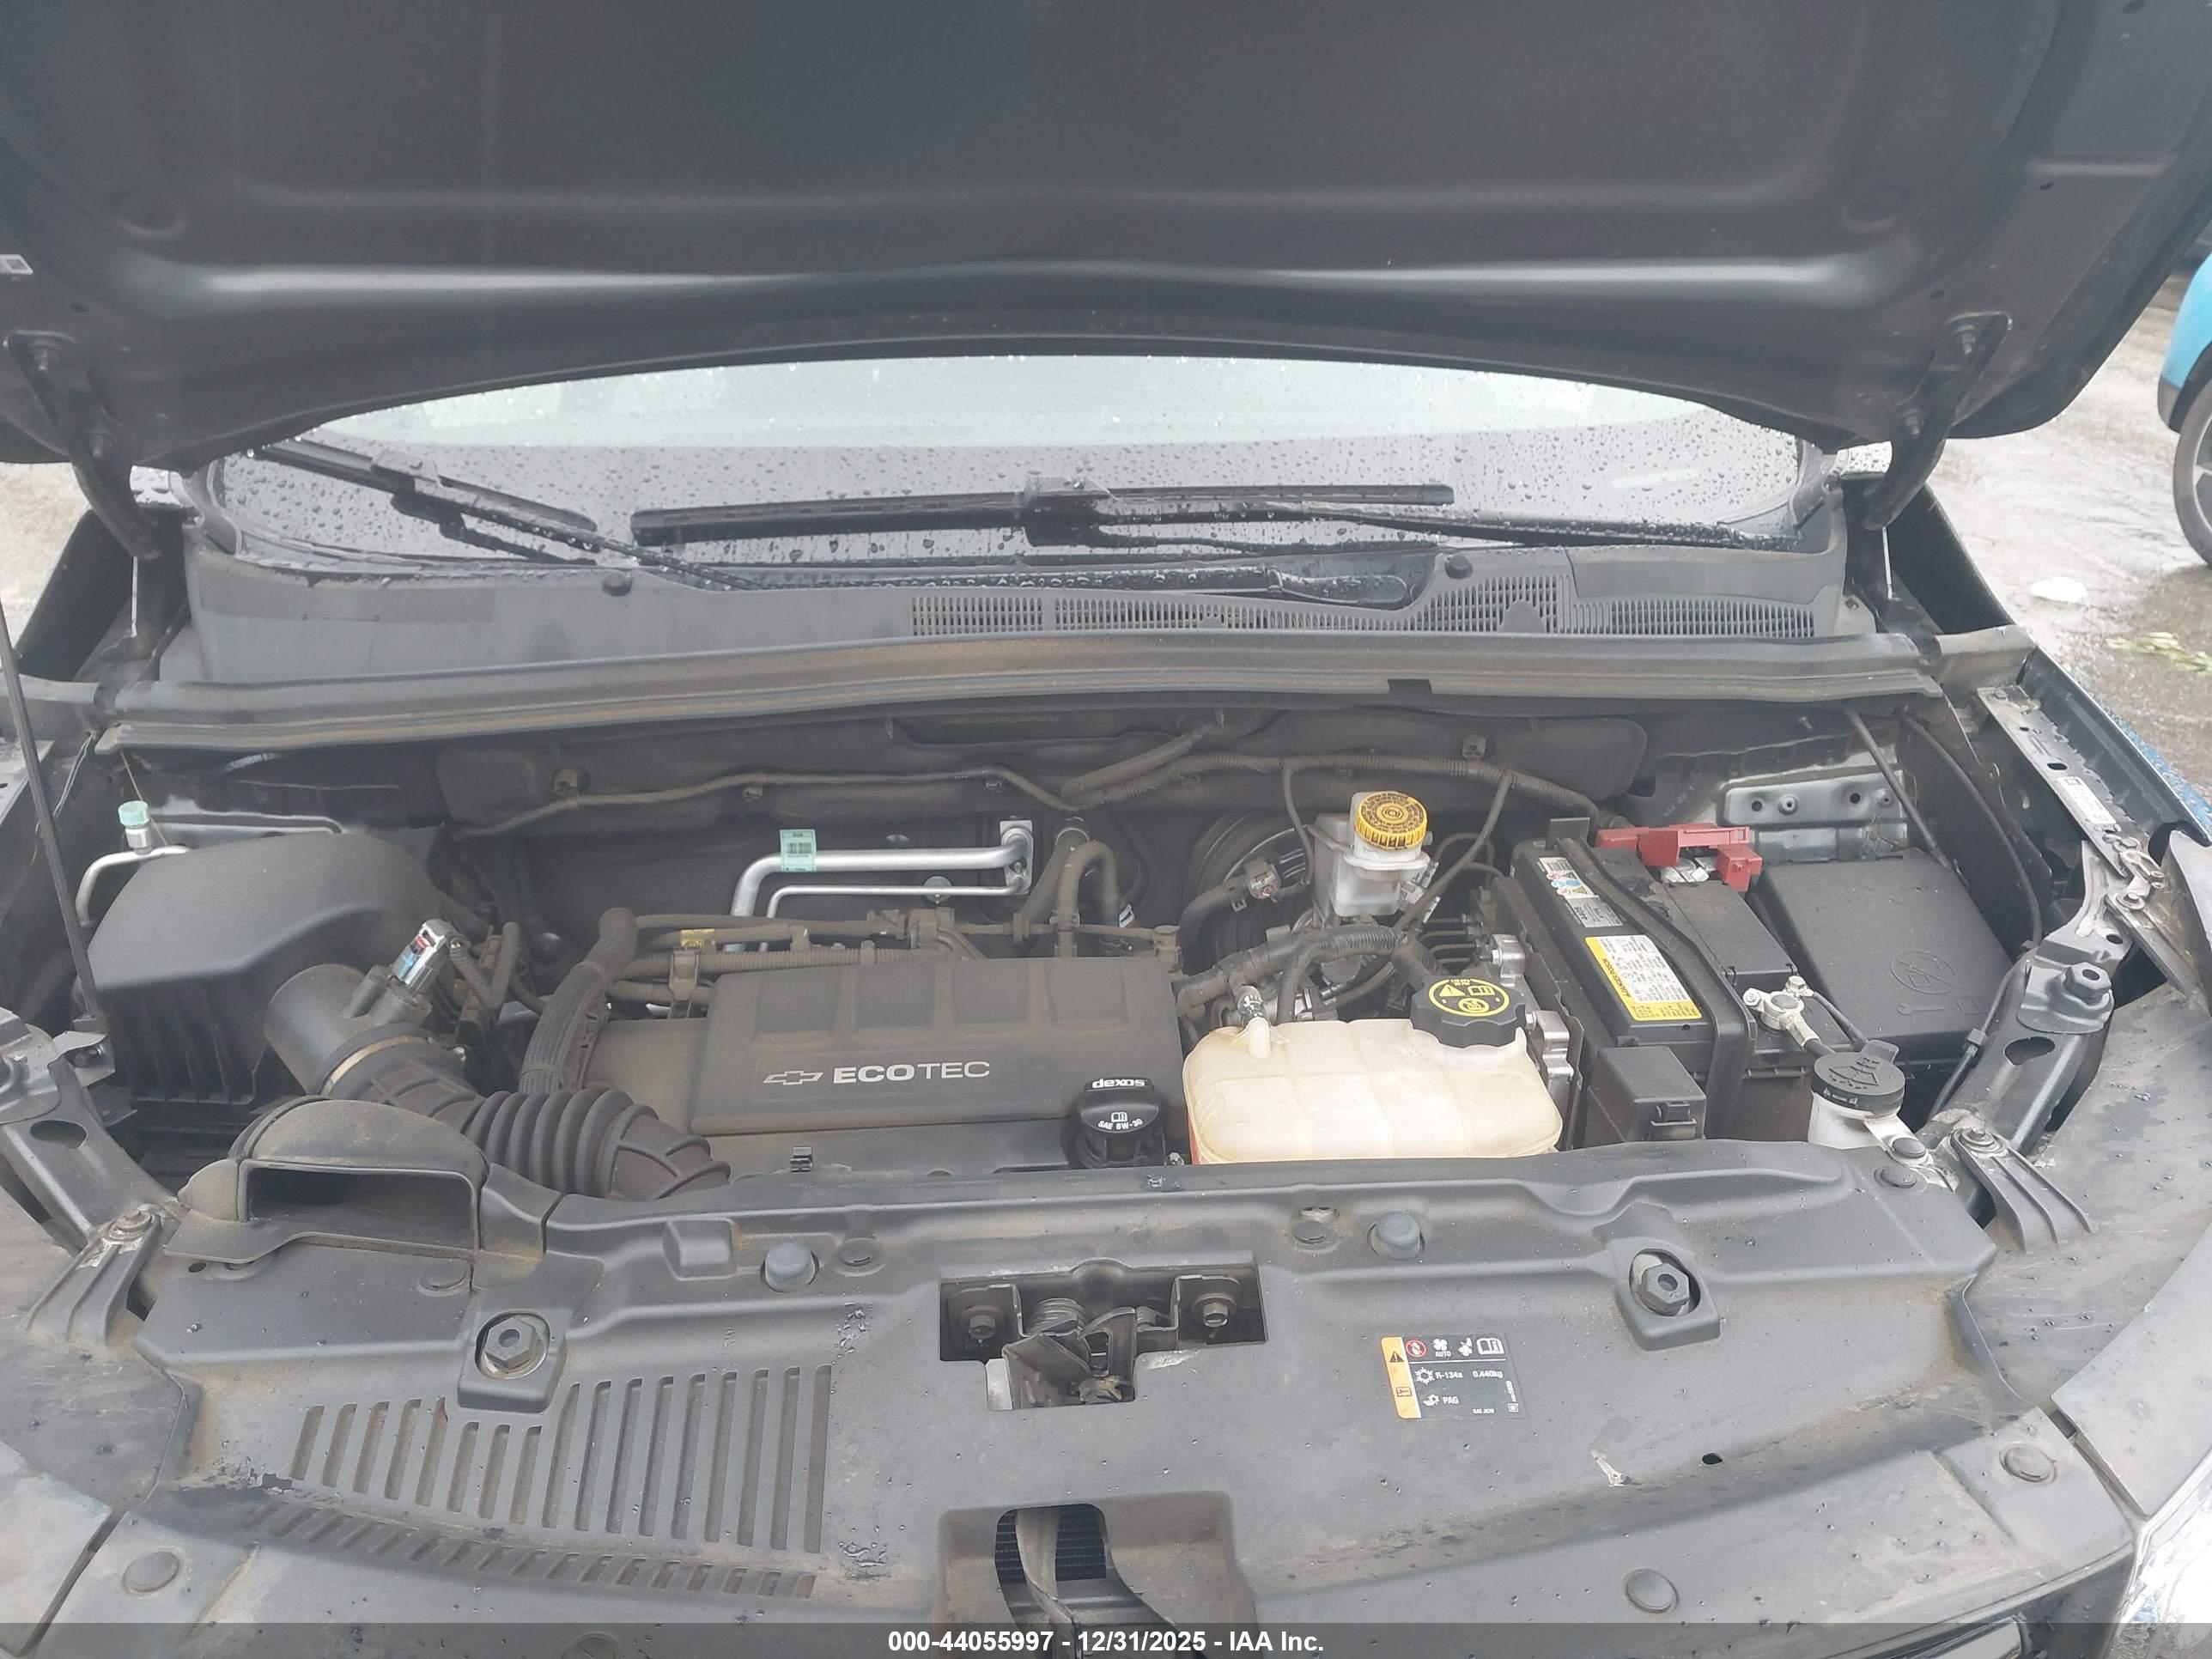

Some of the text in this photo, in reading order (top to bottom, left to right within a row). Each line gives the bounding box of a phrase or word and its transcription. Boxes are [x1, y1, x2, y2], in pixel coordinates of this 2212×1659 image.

[833, 1061, 990, 1084] ECOTEC
[1092, 1078, 1146, 1089] dexos
[1097, 1118, 1143, 1130] SAE 5W-30
[1442, 1396, 1460, 1405] PAG
